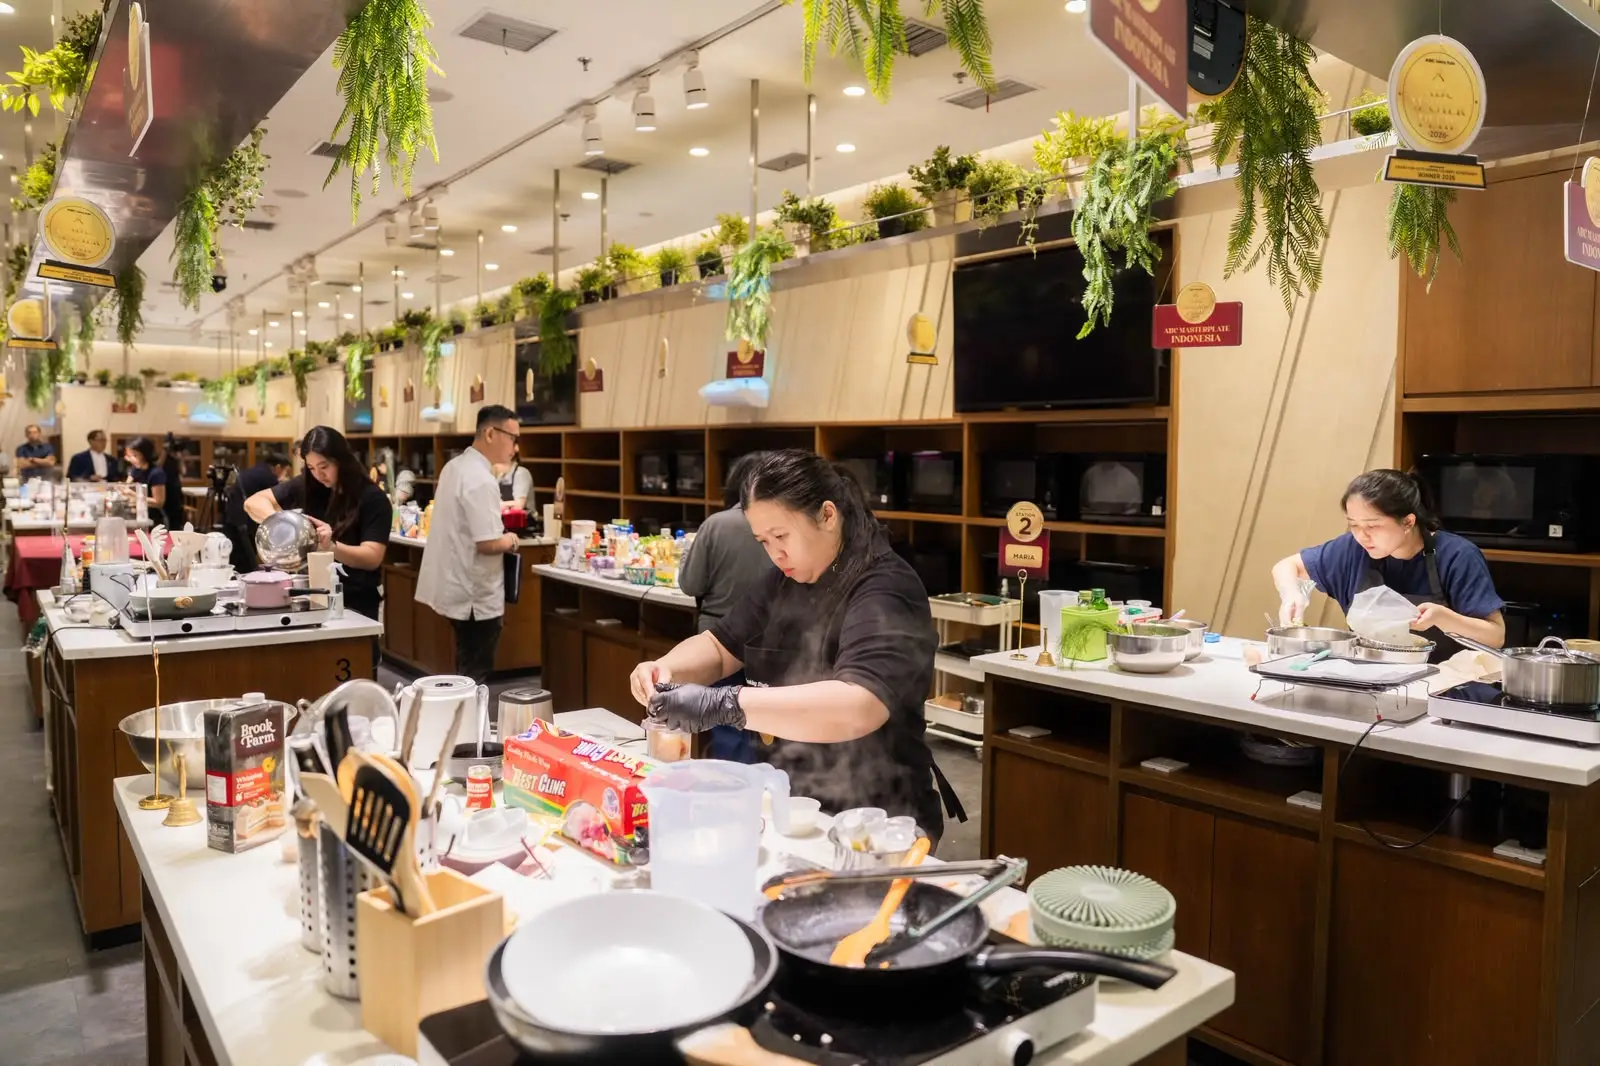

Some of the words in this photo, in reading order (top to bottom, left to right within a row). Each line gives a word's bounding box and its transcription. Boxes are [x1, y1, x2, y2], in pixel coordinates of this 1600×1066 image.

[1171, 334, 1221, 343] INDONESIA
[1179, 325, 1230, 334] MASTERPLATE
[1019, 517, 1031, 535] 2
[335, 658, 351, 682] 3
[240, 718, 277, 738] Brook
[240, 732, 276, 749] Farm
[511, 763, 538, 791] BEST
[538, 773, 567, 798] CLING
